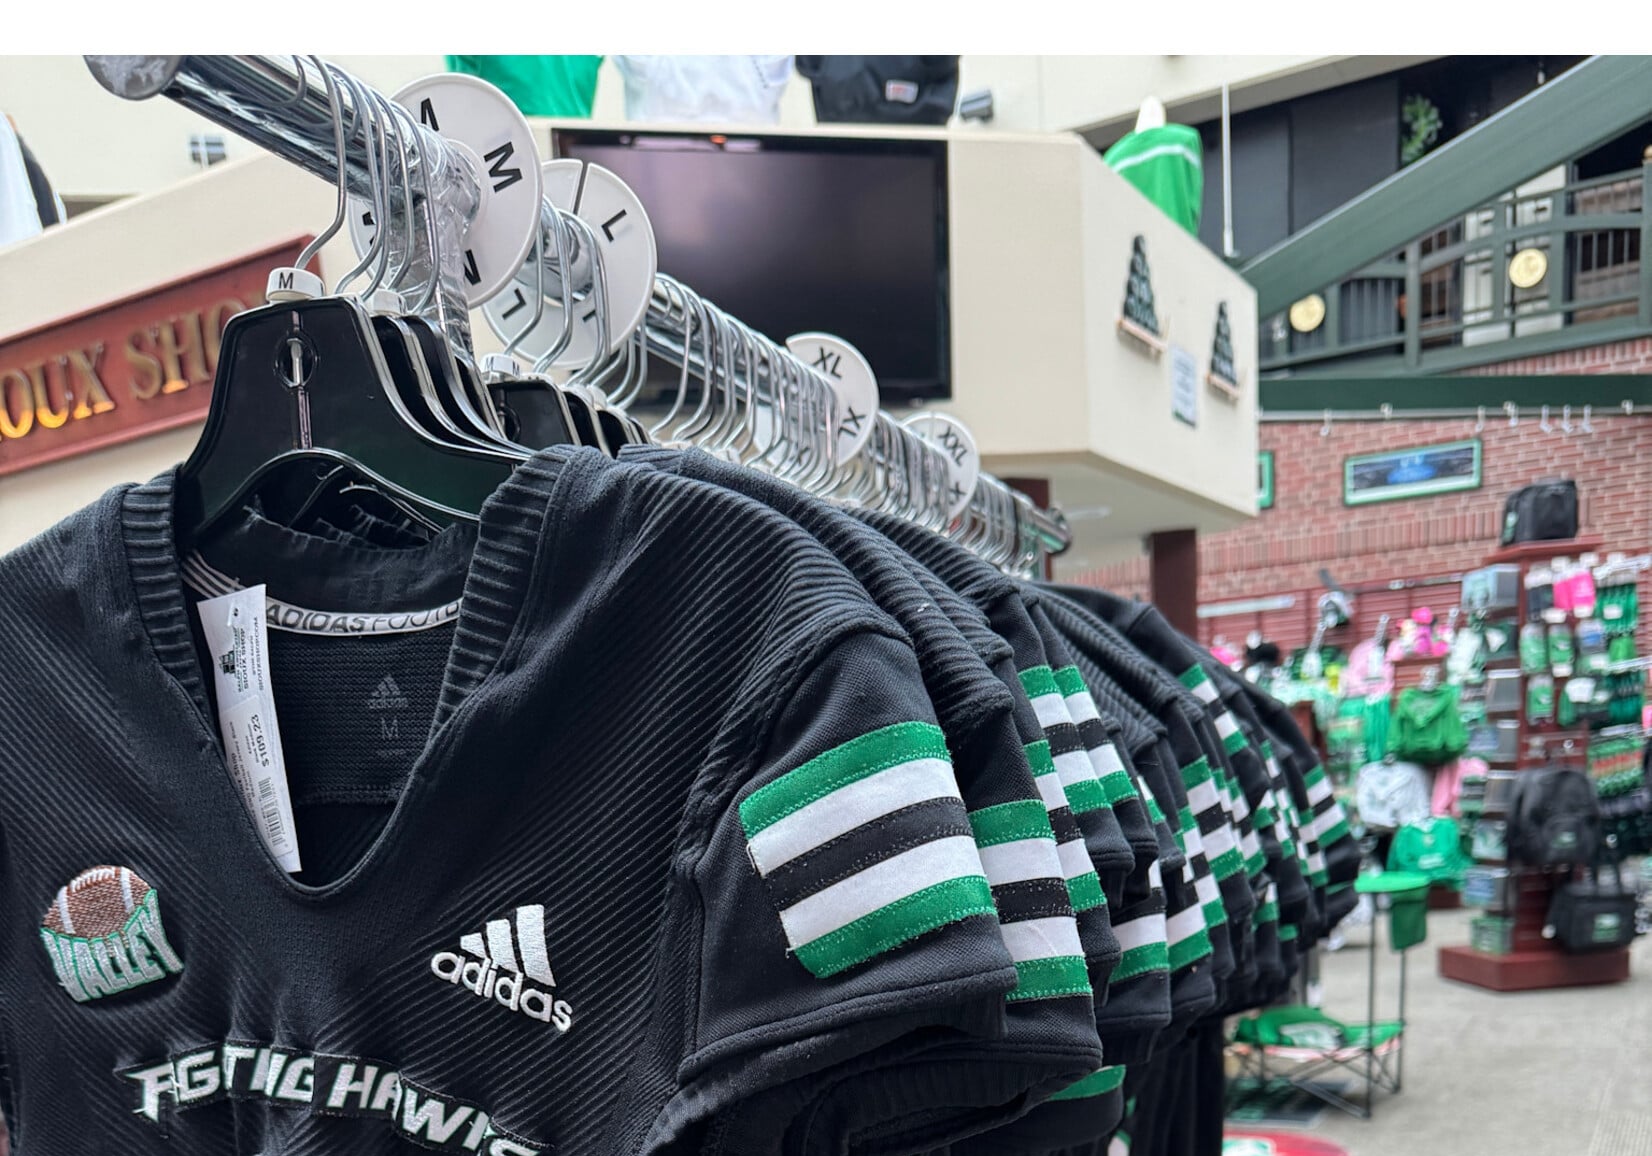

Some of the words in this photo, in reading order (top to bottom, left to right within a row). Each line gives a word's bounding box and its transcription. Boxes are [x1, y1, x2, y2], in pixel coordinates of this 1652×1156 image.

[483, 141, 523, 193] M
[601, 209, 627, 243] L
[279, 272, 294, 289] M
[502, 288, 527, 320] L
[0, 338, 118, 442] OUX
[125, 291, 267, 400] SHO
[813, 346, 842, 379] XL
[939, 426, 968, 467] XXL
[266, 604, 367, 632] ADIDAS
[251, 714, 270, 767] $109.23
[40, 889, 184, 1003] VALLEY
[431, 952, 573, 1032] adidas
